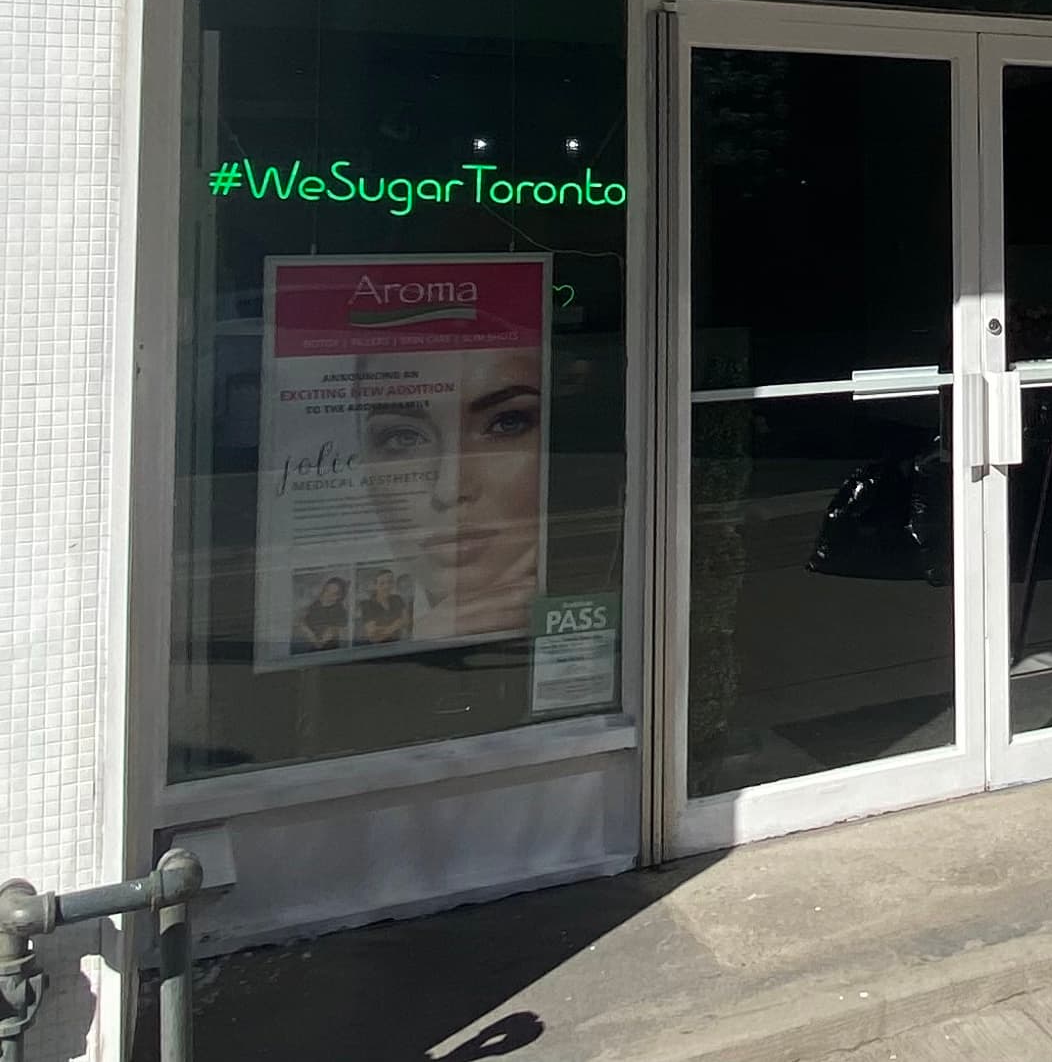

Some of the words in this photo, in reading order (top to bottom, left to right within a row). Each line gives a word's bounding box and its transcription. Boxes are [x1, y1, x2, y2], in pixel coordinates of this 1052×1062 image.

[208, 157, 627, 217] #WeSugarToronto
[347, 273, 478, 305] Aroma
[279, 388, 347, 402] EXCITING
[351, 386, 383, 398] NEW
[386, 381, 457, 396] ADDITION
[290, 478, 353, 491] MEDICAL
[546, 606, 608, 634] PASS
